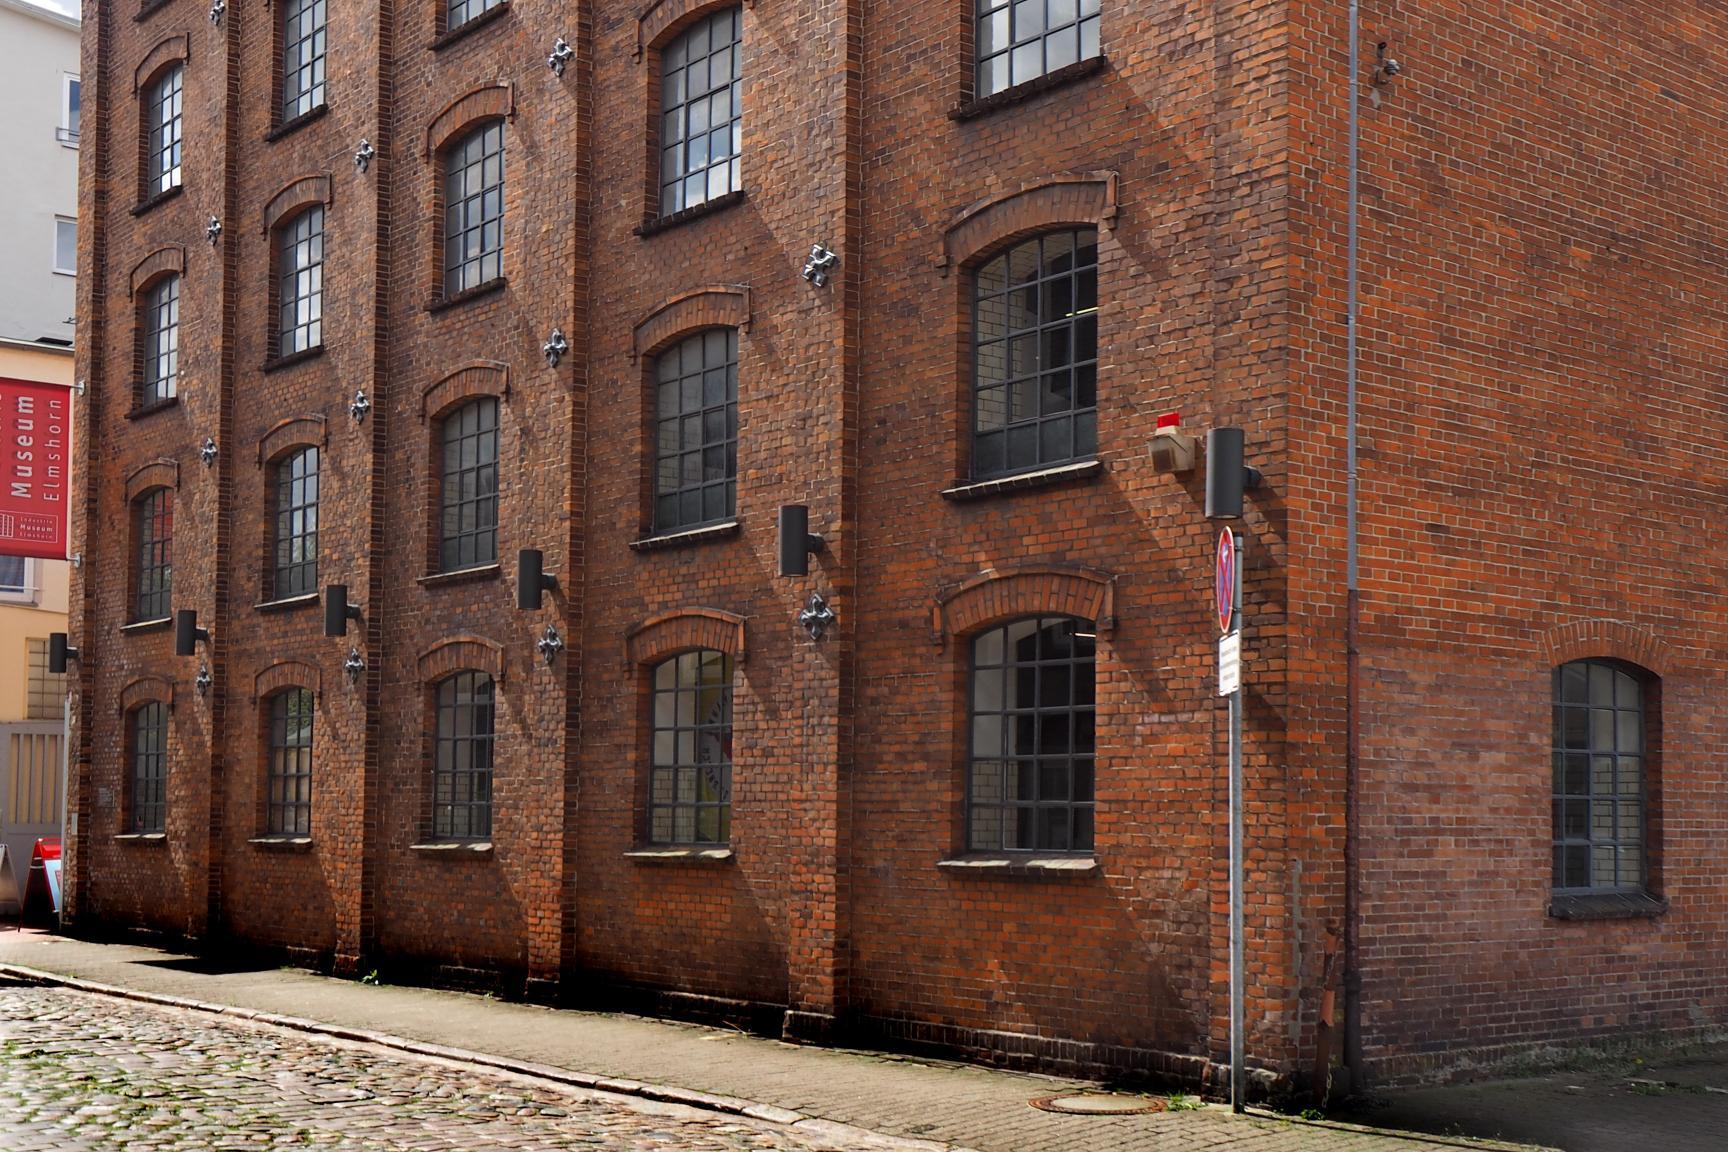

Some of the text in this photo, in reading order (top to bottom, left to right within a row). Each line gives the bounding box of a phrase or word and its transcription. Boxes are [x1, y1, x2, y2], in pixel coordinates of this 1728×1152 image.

[11, 396, 34, 499] Museum
[43, 400, 62, 501] Elmshorn
[20, 523, 53, 533] Museum
